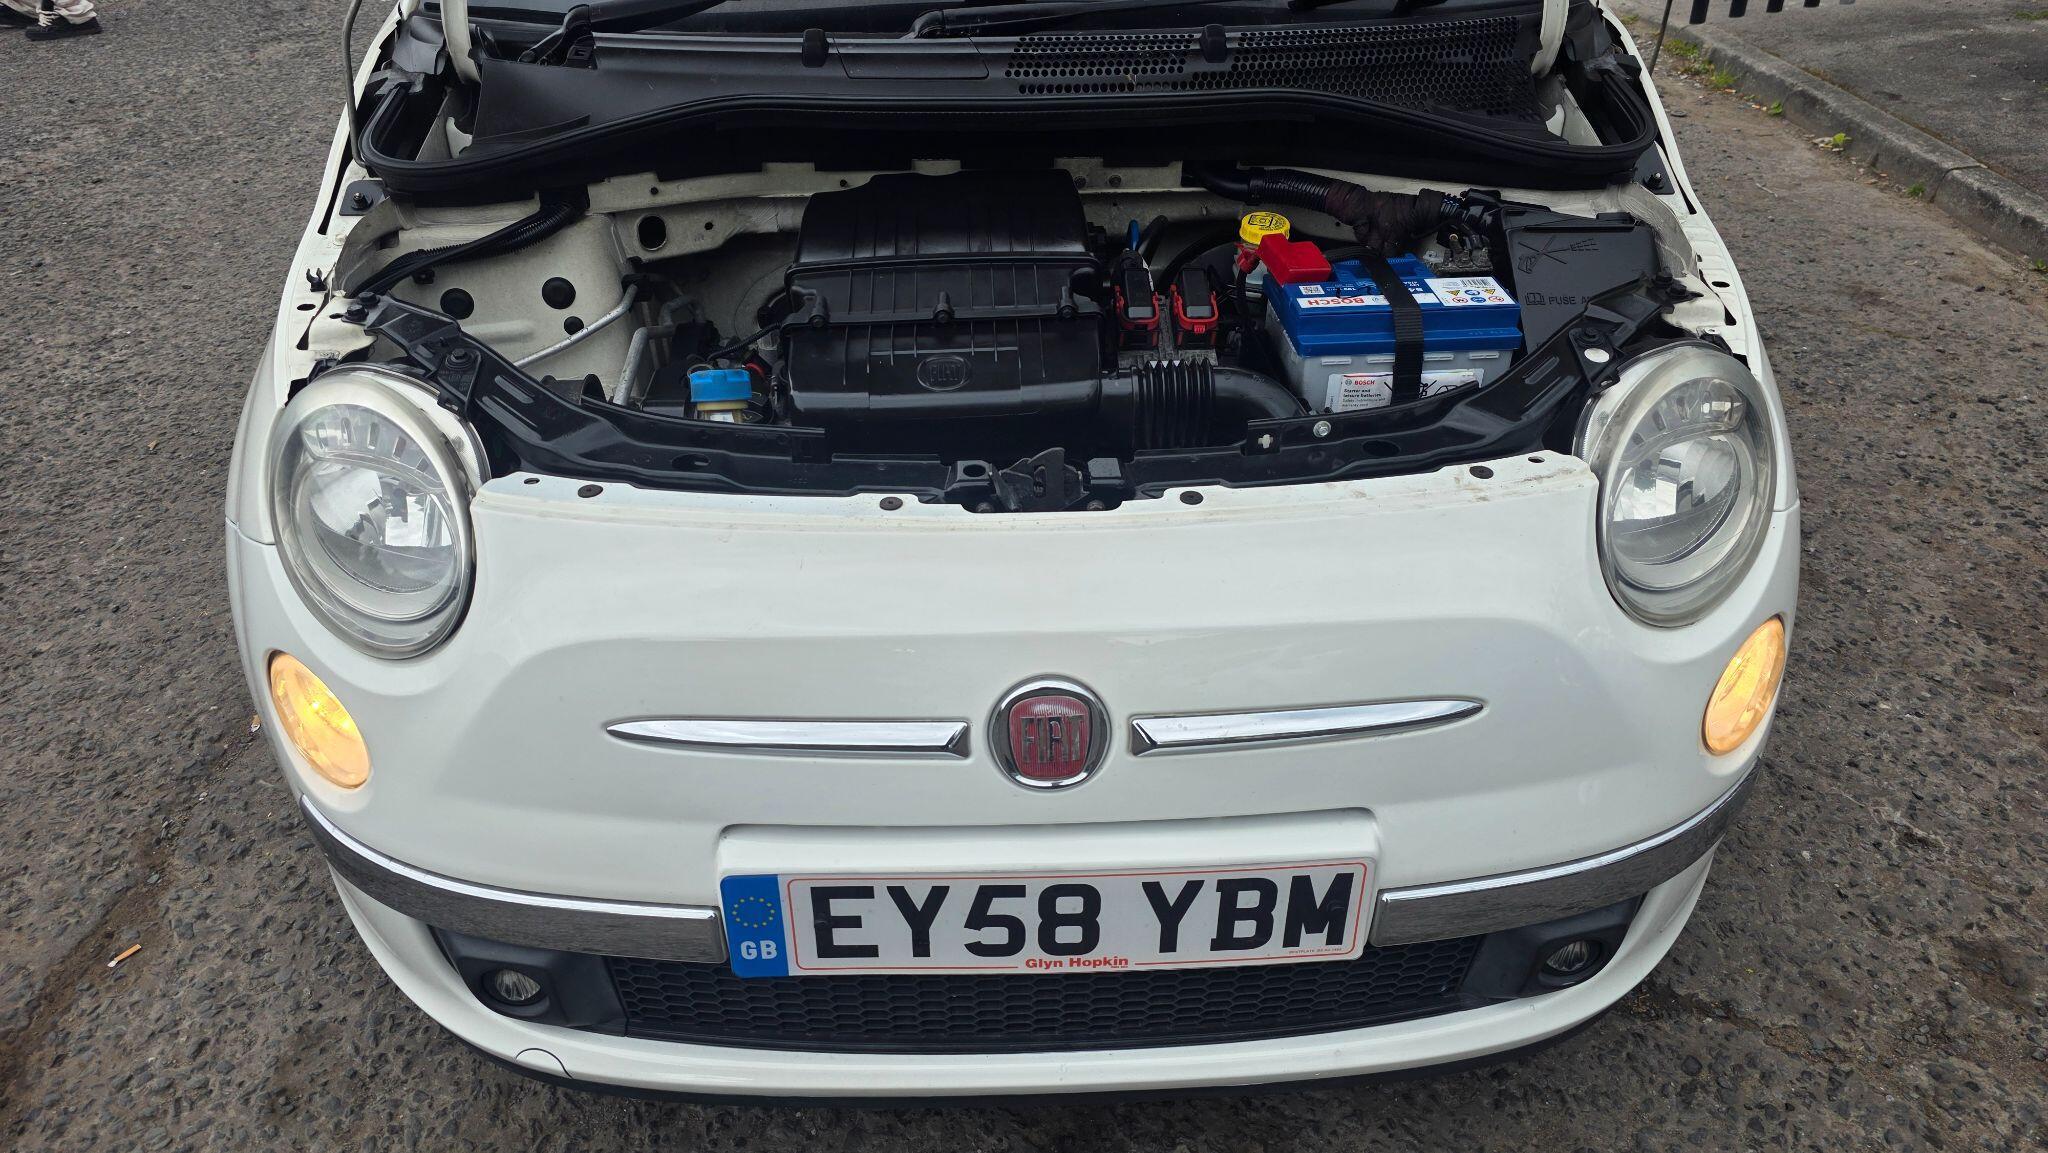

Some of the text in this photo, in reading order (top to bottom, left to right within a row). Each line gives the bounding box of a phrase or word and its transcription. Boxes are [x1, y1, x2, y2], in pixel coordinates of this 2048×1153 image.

[1307, 296, 1365, 306] BOSCH
[1548, 295, 1577, 305] FUSE
[1020, 715, 1086, 763] FIAT
[810, 872, 1355, 958] EY58 YBM
[740, 940, 778, 960] GB
[1025, 956, 1129, 970] Glyn Hopkin
